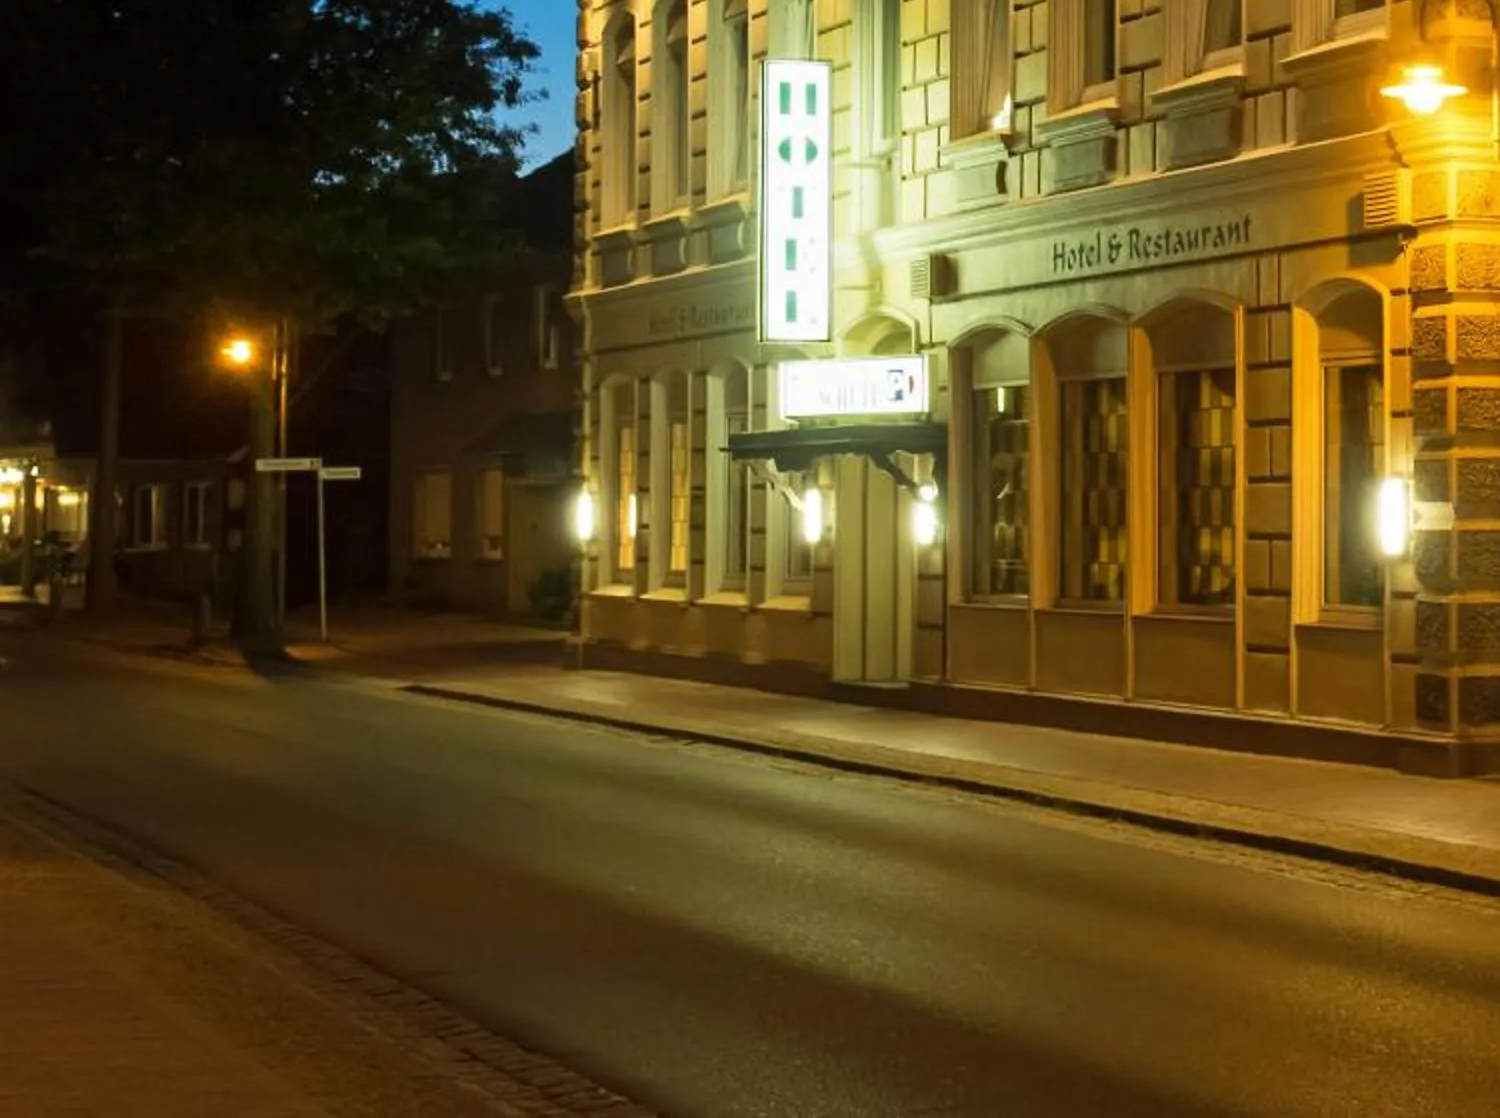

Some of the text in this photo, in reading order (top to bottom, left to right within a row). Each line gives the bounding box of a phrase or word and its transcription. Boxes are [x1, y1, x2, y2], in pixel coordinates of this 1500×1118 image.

[1052, 214, 1252, 273] Hotel & Restaurant
